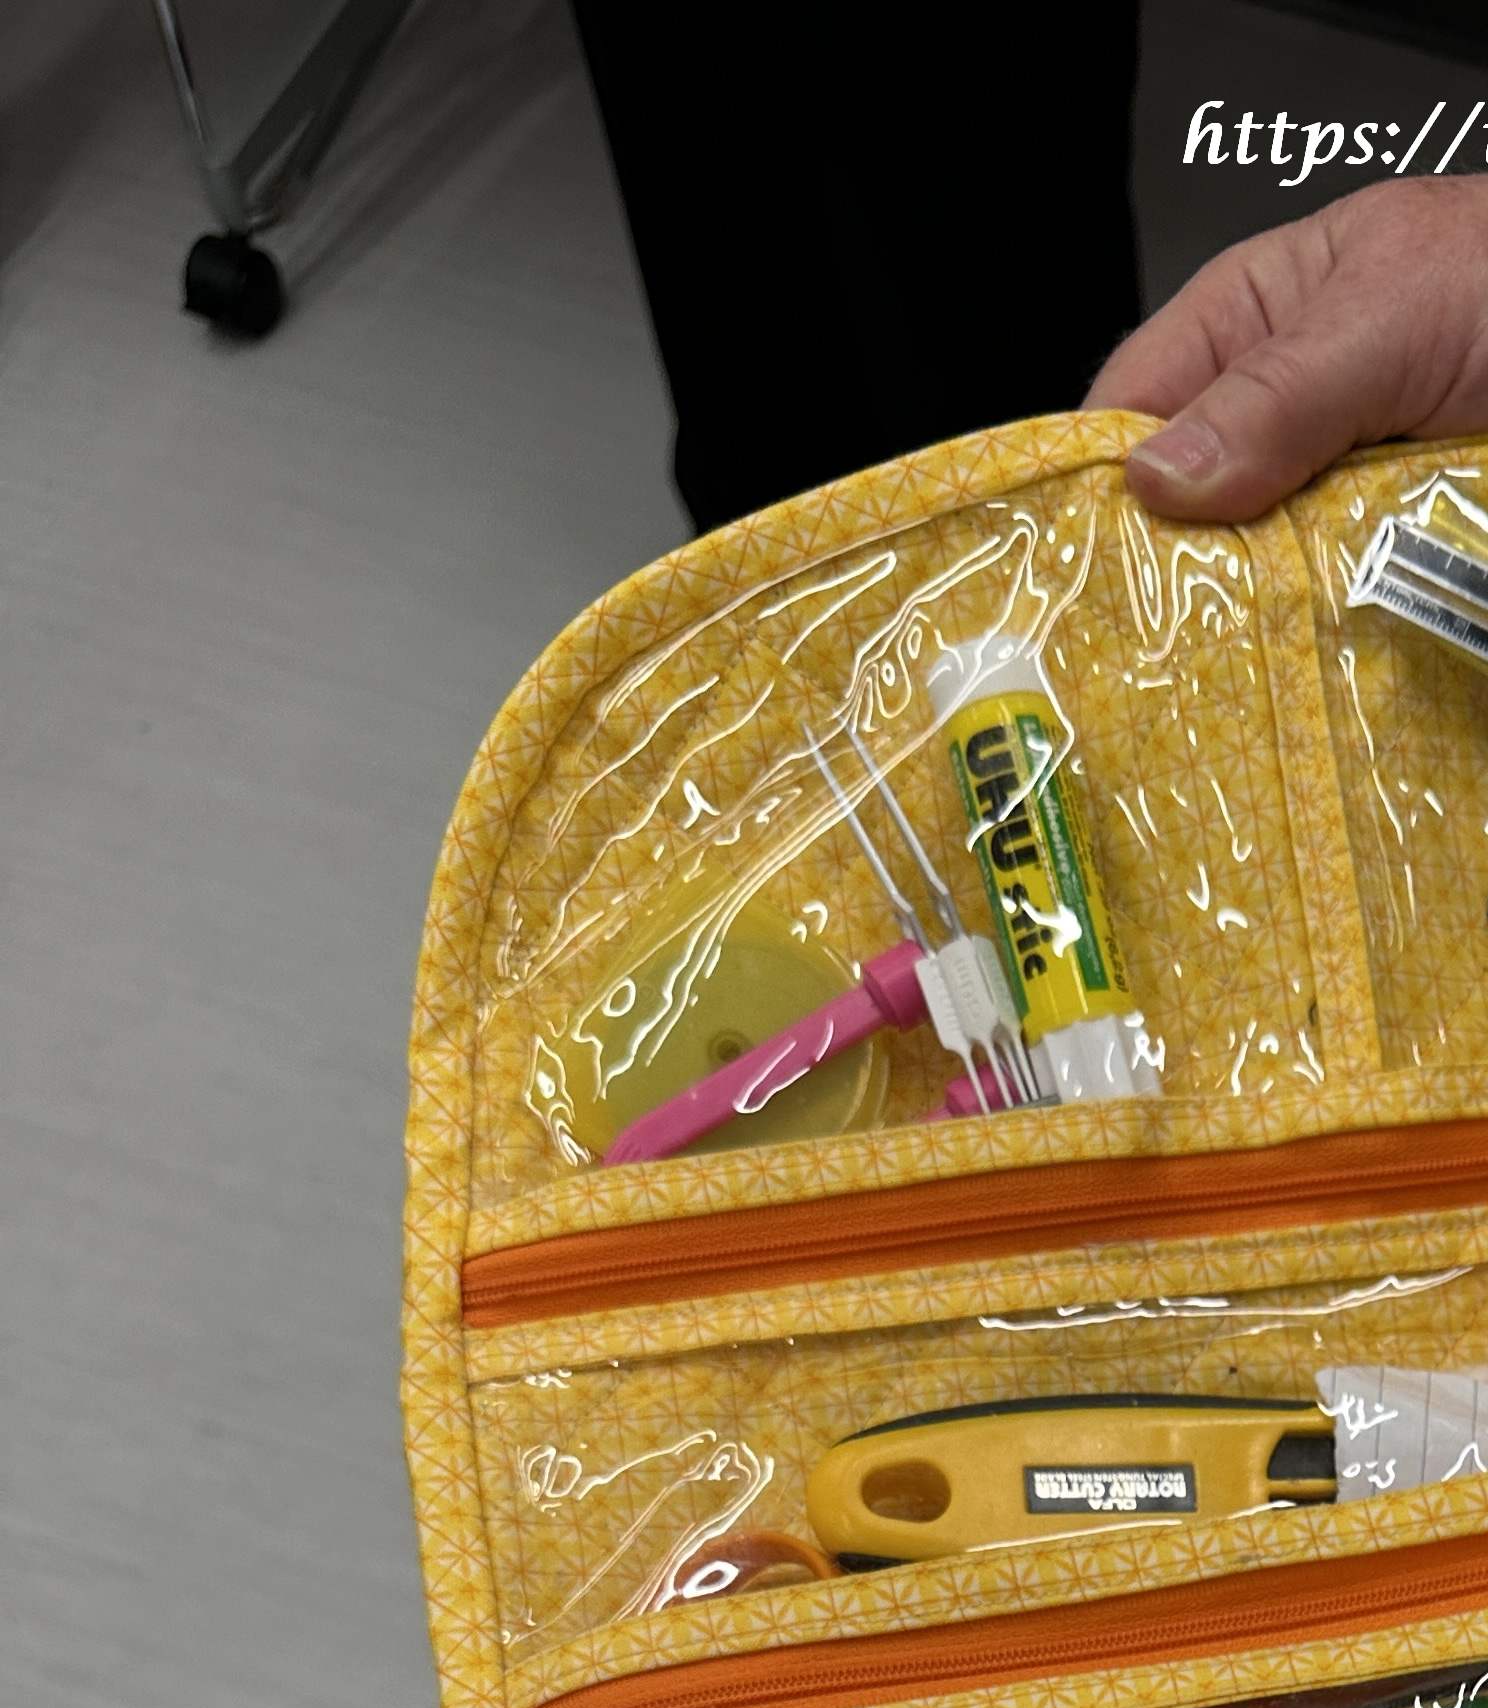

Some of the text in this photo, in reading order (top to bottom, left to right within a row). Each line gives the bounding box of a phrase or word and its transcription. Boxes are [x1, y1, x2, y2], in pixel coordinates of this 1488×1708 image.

[964, 726, 1040, 873] UHU
[1034, 1481, 1186, 1498] ROTARY CUTTER
[1087, 1498, 1136, 1510] OLFA
